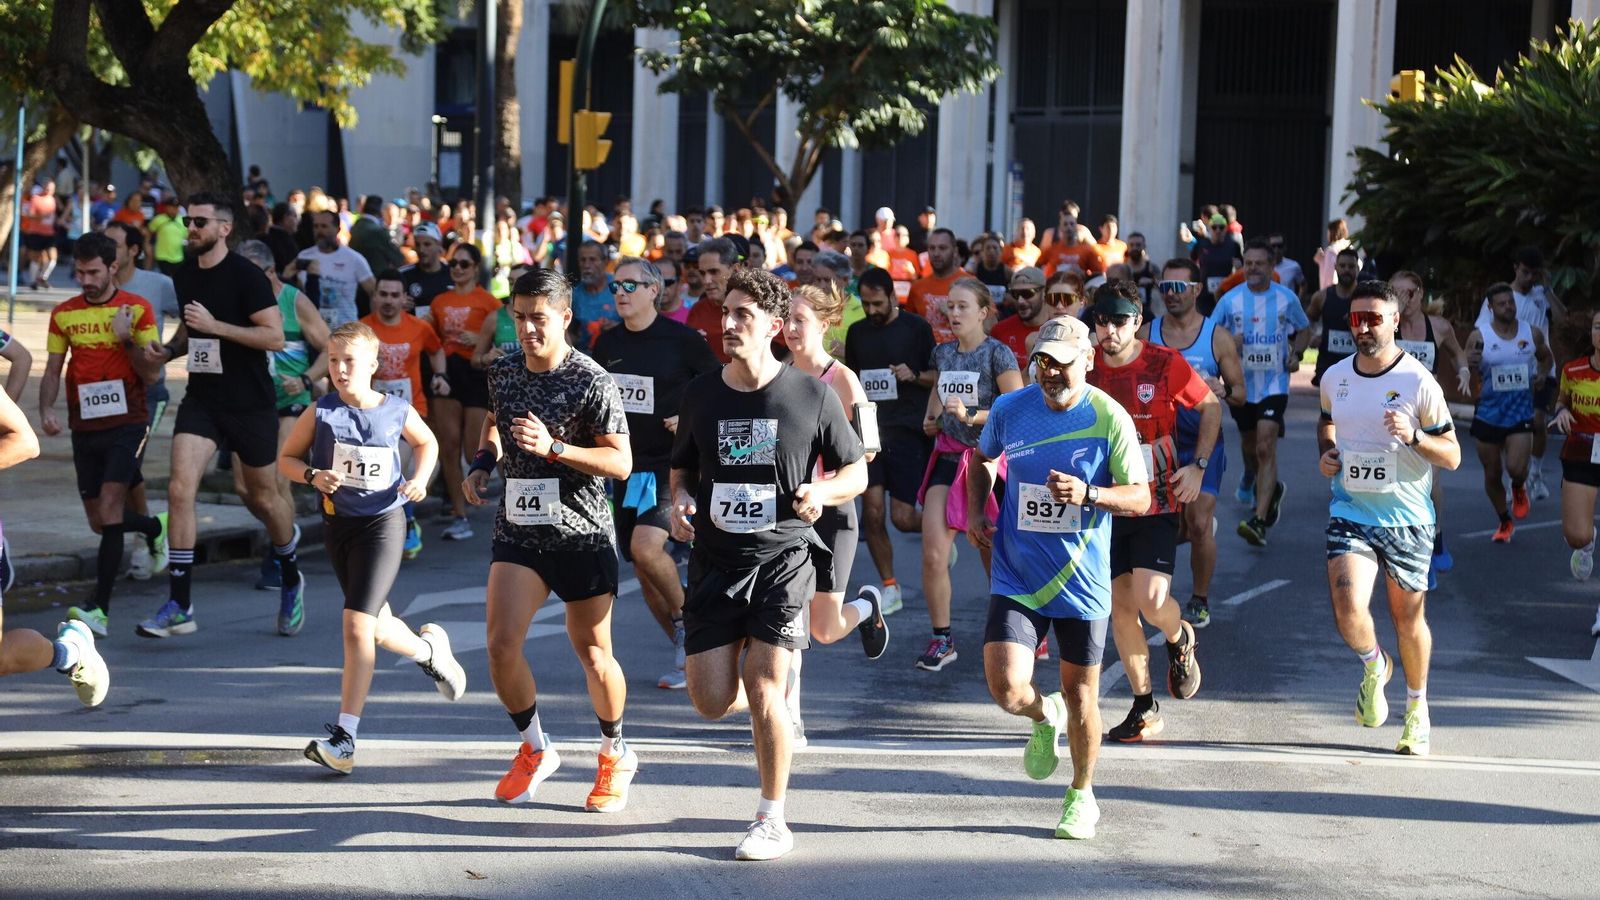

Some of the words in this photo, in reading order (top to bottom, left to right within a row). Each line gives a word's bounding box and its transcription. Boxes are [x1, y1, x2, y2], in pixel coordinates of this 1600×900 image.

[193, 351, 209, 363] 92
[1247, 353, 1272, 363] 498
[865, 379, 889, 391] 800
[941, 383, 974, 394] 1009
[84, 392, 120, 407] 1090
[618, 387, 646, 401] 270
[342, 460, 381, 477] 112
[1349, 465, 1386, 481] 976
[515, 495, 542, 512] 44
[719, 501, 763, 518] 742
[1026, 501, 1067, 518] 937
